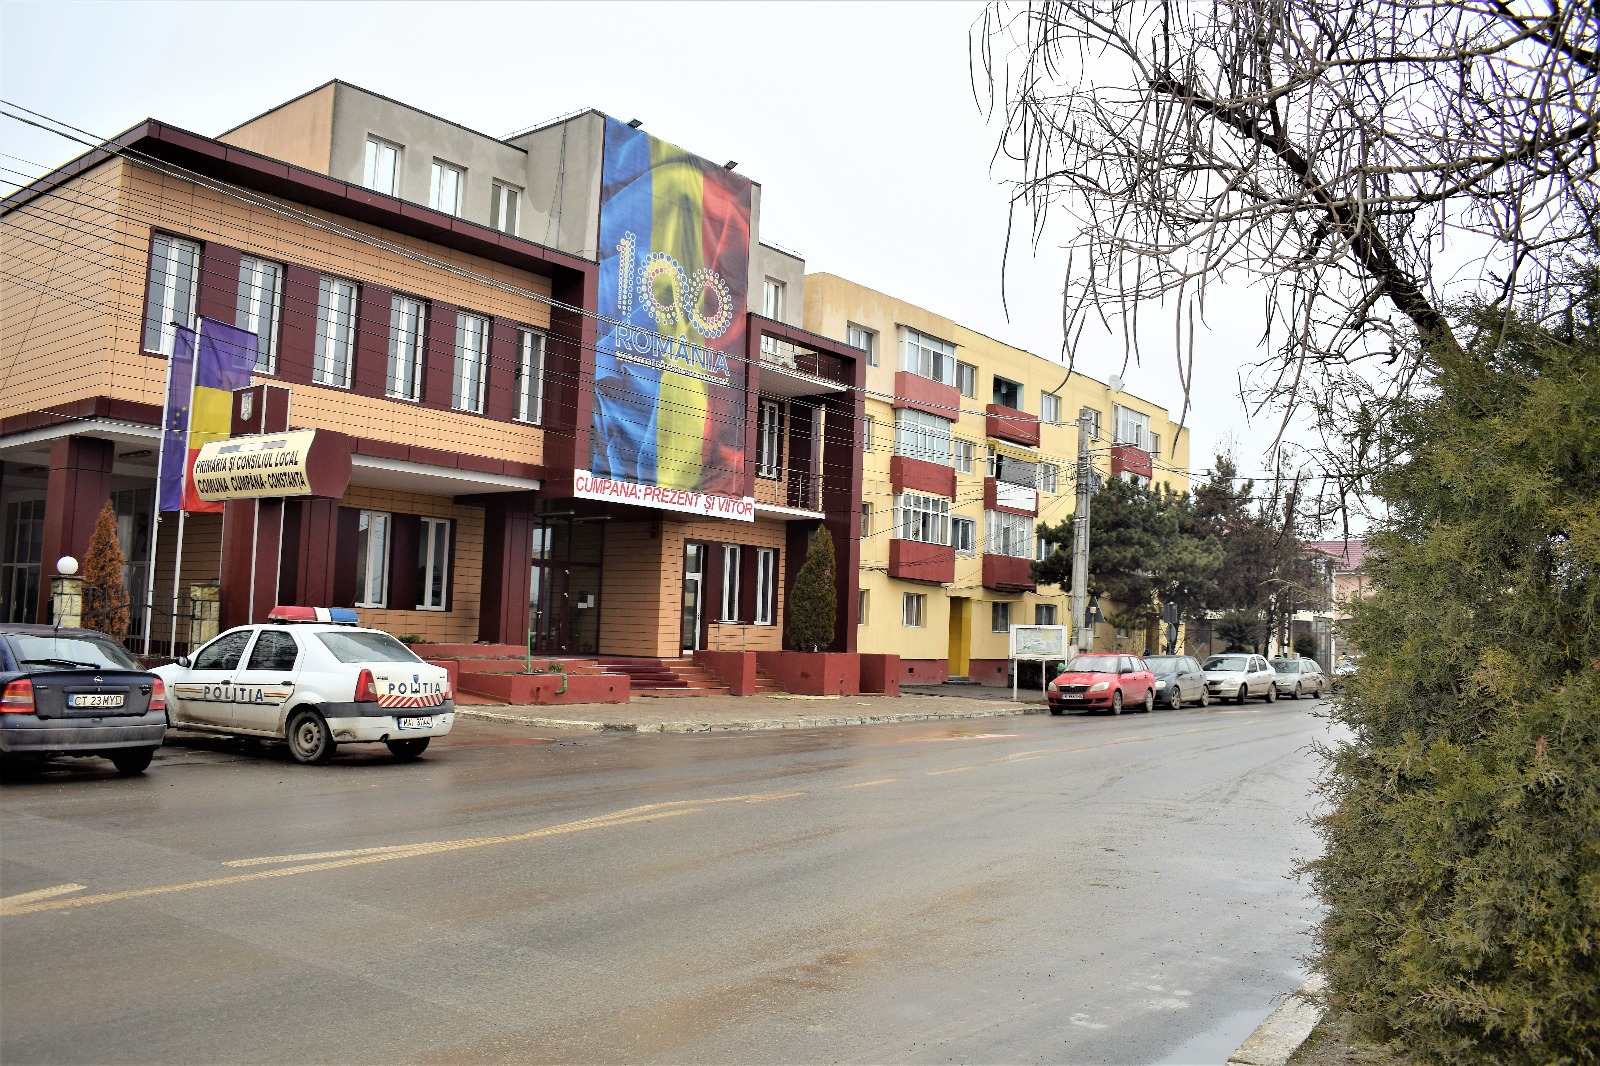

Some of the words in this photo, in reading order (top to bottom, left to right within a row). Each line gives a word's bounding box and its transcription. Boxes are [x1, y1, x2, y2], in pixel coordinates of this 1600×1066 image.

[616, 231, 733, 339] 100
[615, 324, 731, 376] ROMÂNIA
[236, 452, 274, 470] CONSILIUL
[275, 450, 299, 467] LOCAL
[197, 477, 230, 494] COMUNA
[643, 486, 701, 508] PREZENT
[718, 498, 753, 516] VIITOR
[74, 696, 88, 706] CT
